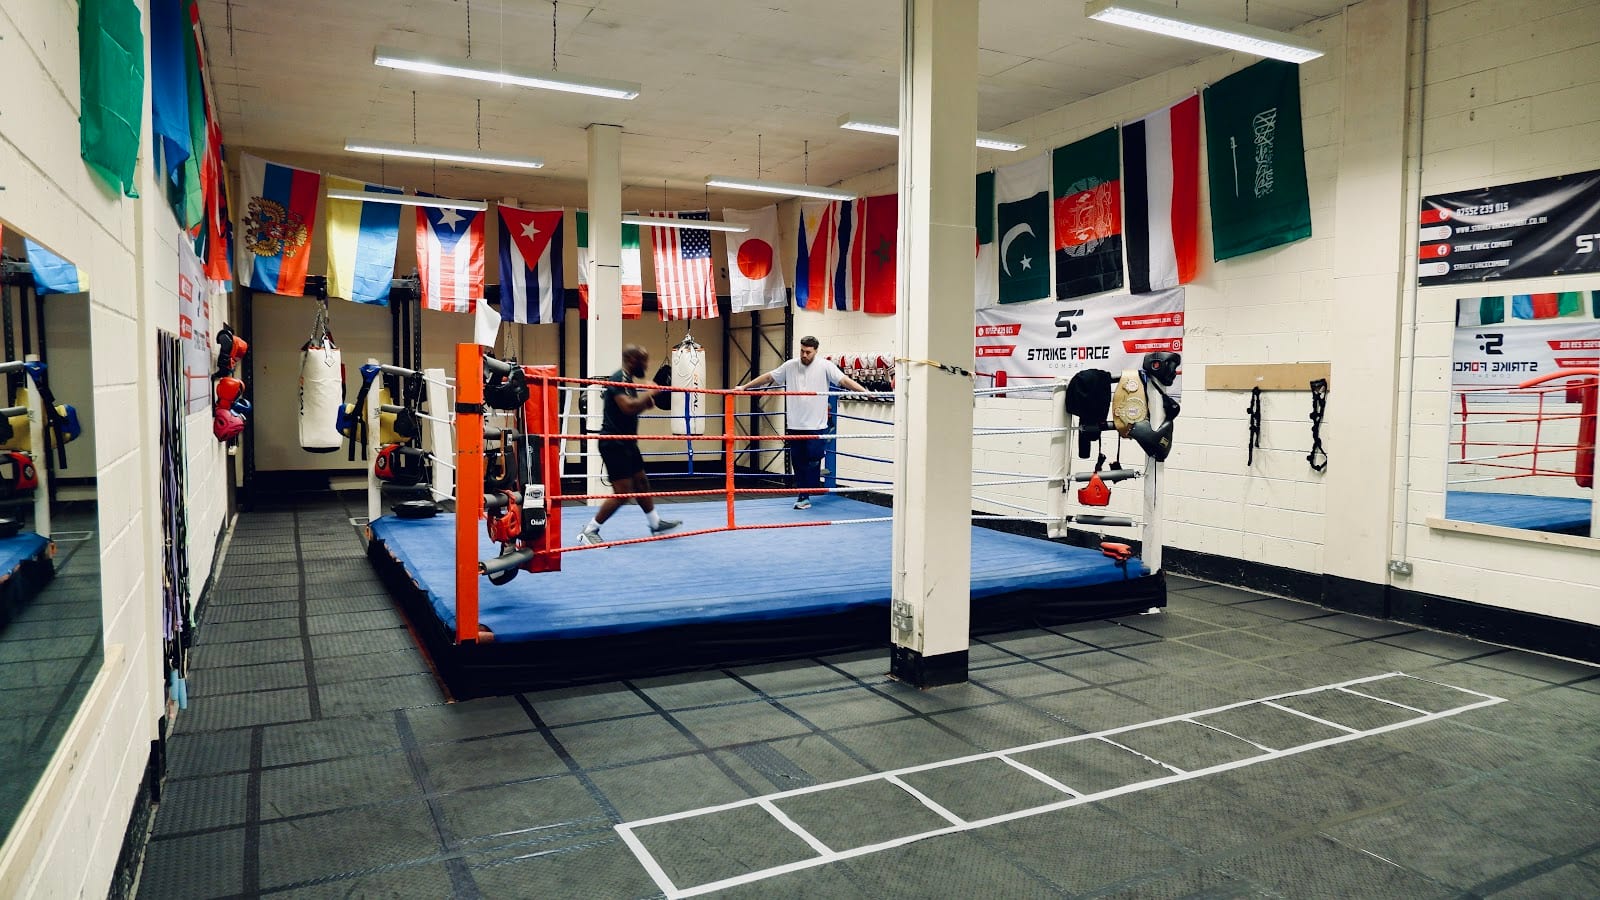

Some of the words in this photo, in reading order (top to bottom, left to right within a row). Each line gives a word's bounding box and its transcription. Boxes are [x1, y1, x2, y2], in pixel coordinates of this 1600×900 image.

[1456, 206, 1478, 217] 07552
[1479, 204, 1494, 214] 239
[1495, 202, 1509, 212] 015
[1027, 346, 1067, 361] STRIKE
[1071, 345, 1111, 360] FORCE
